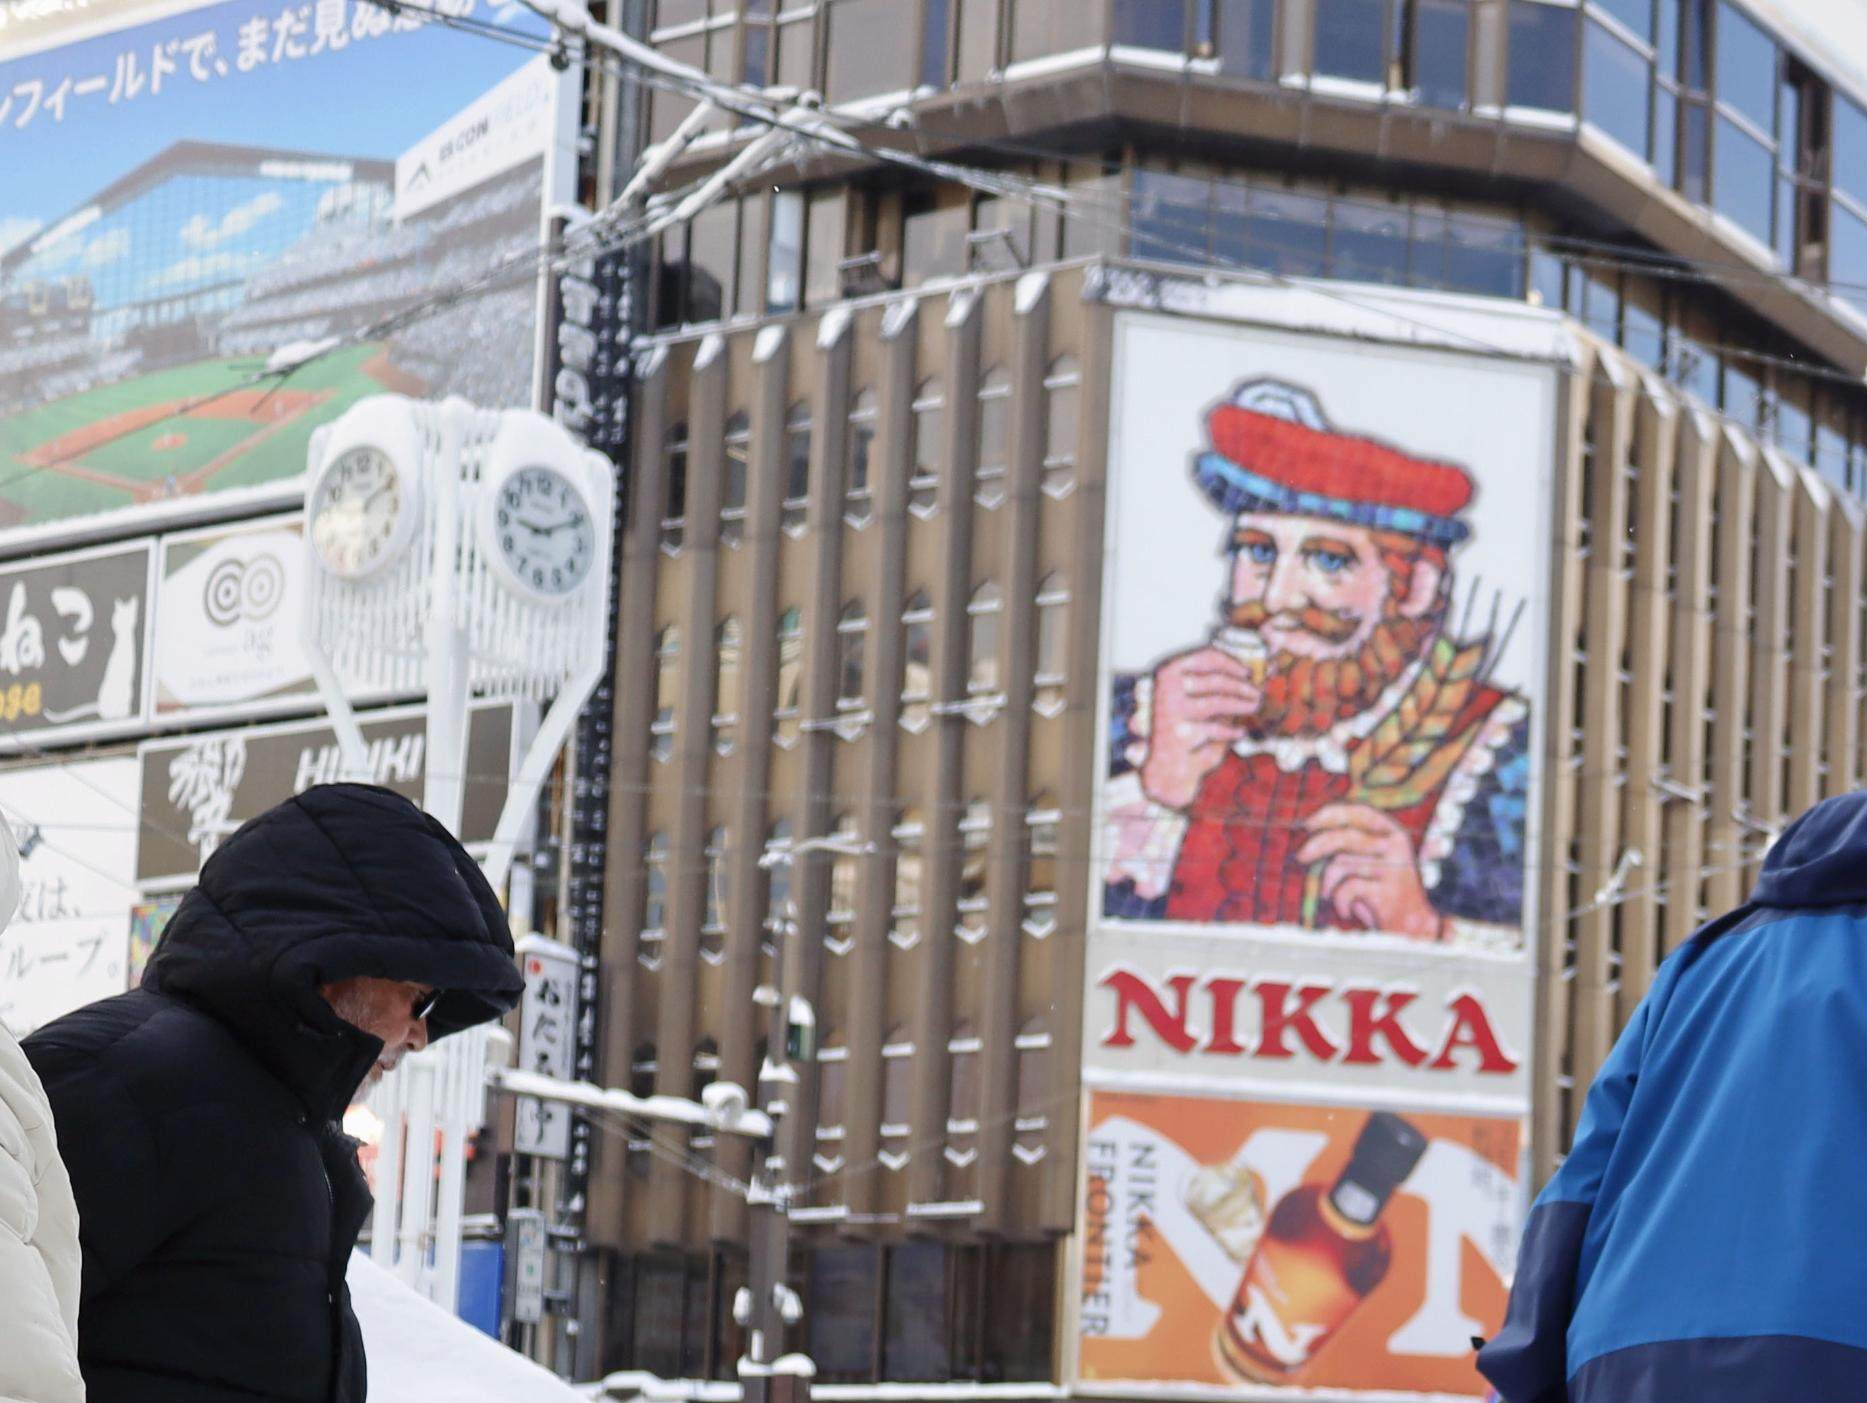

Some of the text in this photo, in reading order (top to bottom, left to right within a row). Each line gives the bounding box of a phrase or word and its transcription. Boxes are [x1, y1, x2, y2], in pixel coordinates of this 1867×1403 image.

[293, 733, 425, 795] HIIKI
[1098, 968, 1520, 1075] NIKKA
[1080, 1141, 1117, 1336] FRONTIER
[1126, 1142, 1157, 1270] NIKKA
